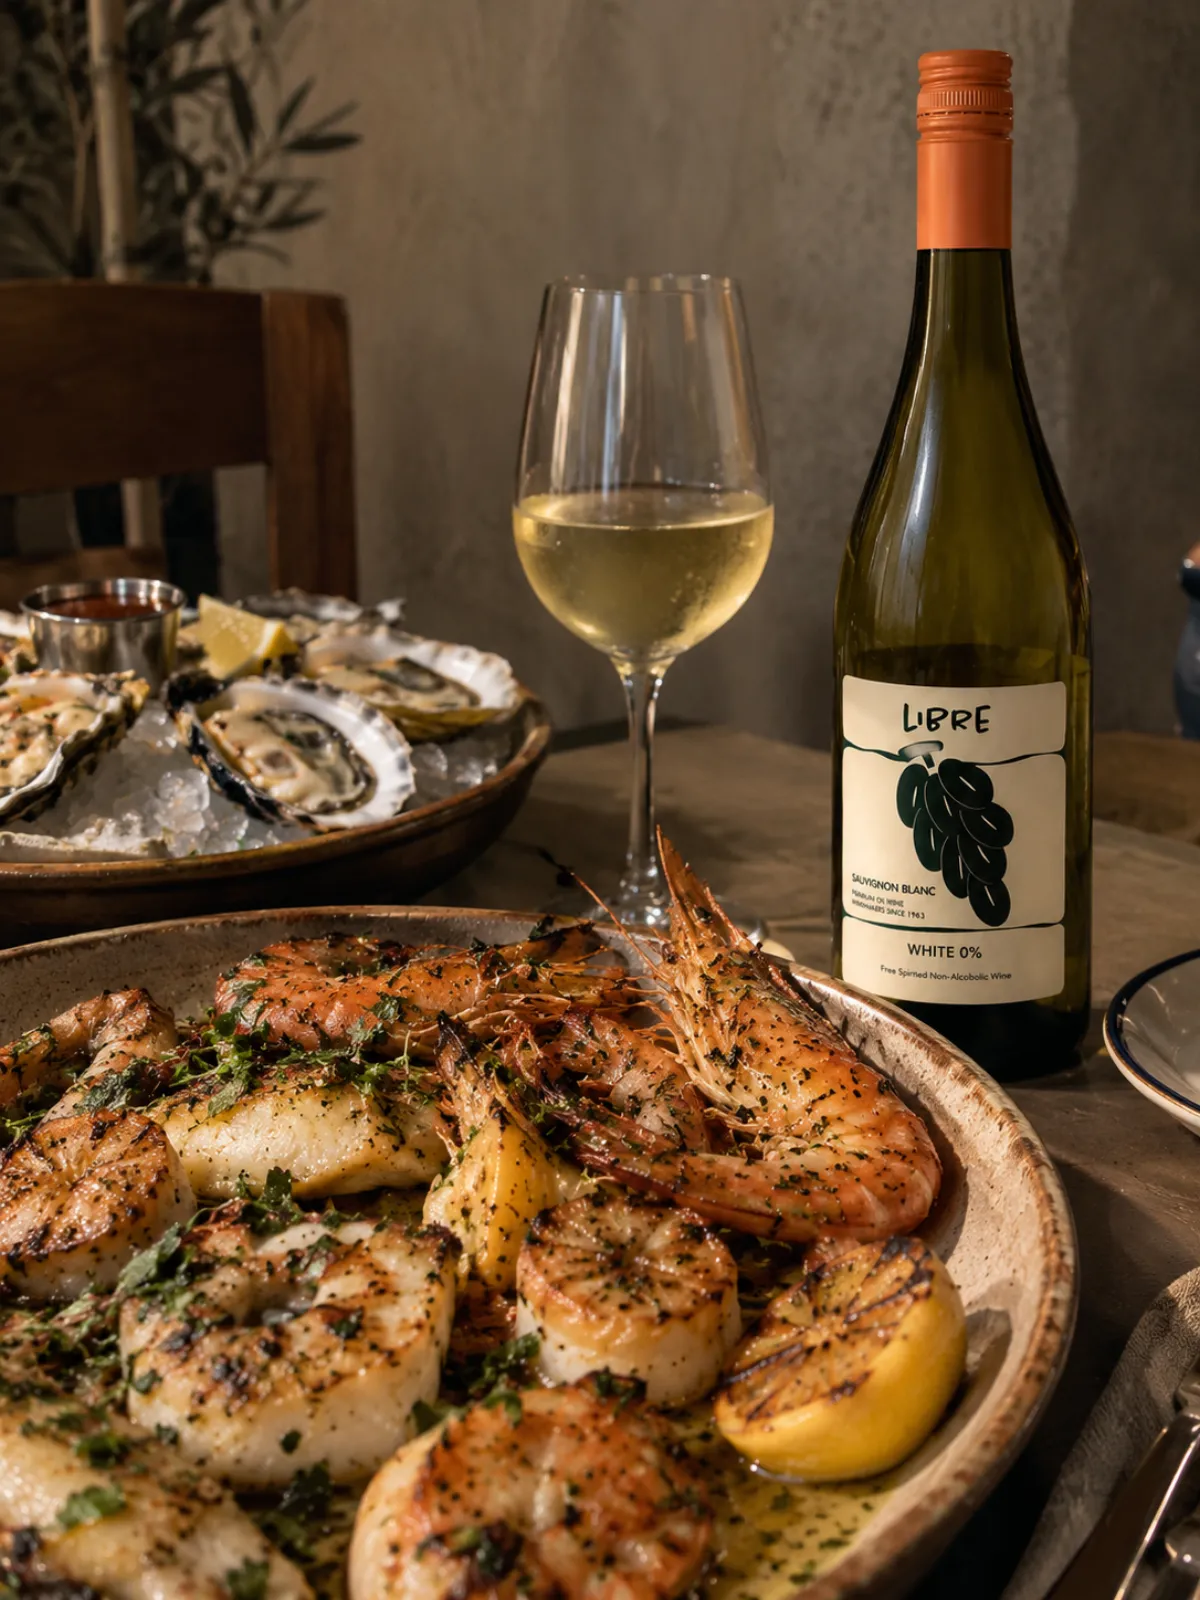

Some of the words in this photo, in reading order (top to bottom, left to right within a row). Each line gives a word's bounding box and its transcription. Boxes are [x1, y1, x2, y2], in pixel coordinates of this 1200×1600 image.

[903, 703, 991, 734] LIBRE
[852, 873, 899, 892] SAUVIGNON
[901, 884, 936, 896] BLANC
[907, 943, 955, 958] WHITE
[959, 946, 982, 959] 0%
[880, 964, 897, 975] Free
[990, 972, 1012, 980] Wine
